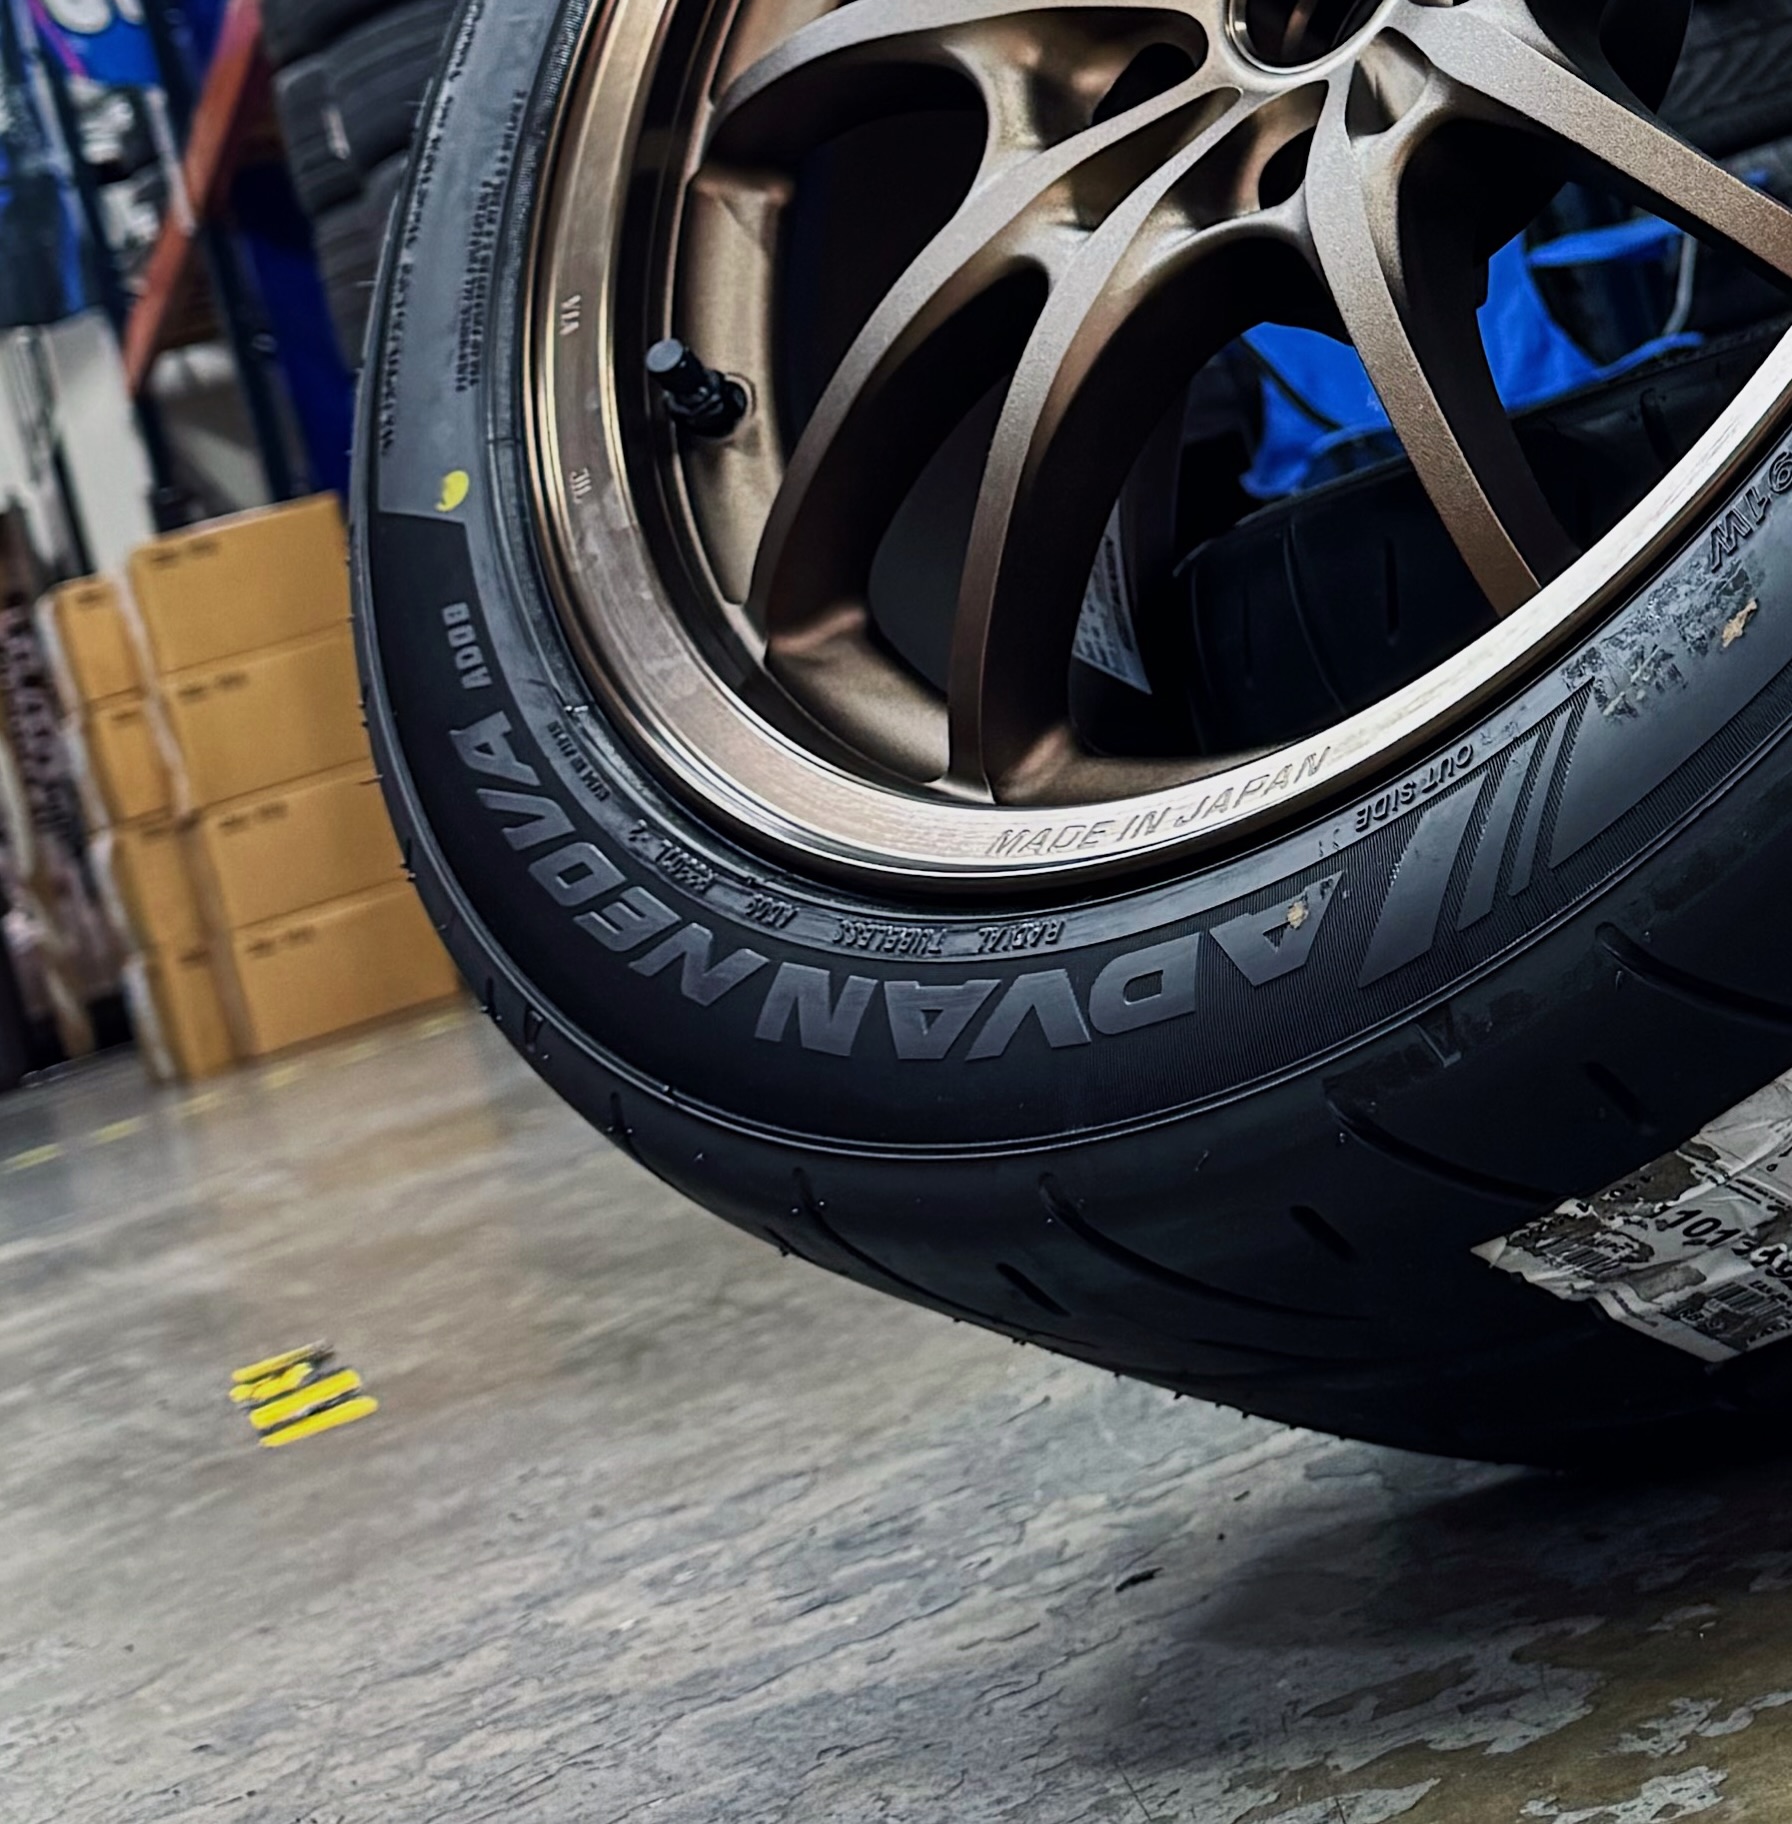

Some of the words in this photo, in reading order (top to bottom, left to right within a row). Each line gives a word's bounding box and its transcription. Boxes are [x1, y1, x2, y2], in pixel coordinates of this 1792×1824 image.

[448, 709, 771, 1007] NEOVA
[986, 823, 1107, 858] MADE
[1117, 808, 1164, 844] IN
[1176, 746, 1331, 825] JAPAN
[1355, 742, 1475, 834] OUTSIDE
[753, 870, 1344, 1061] ADVAN
